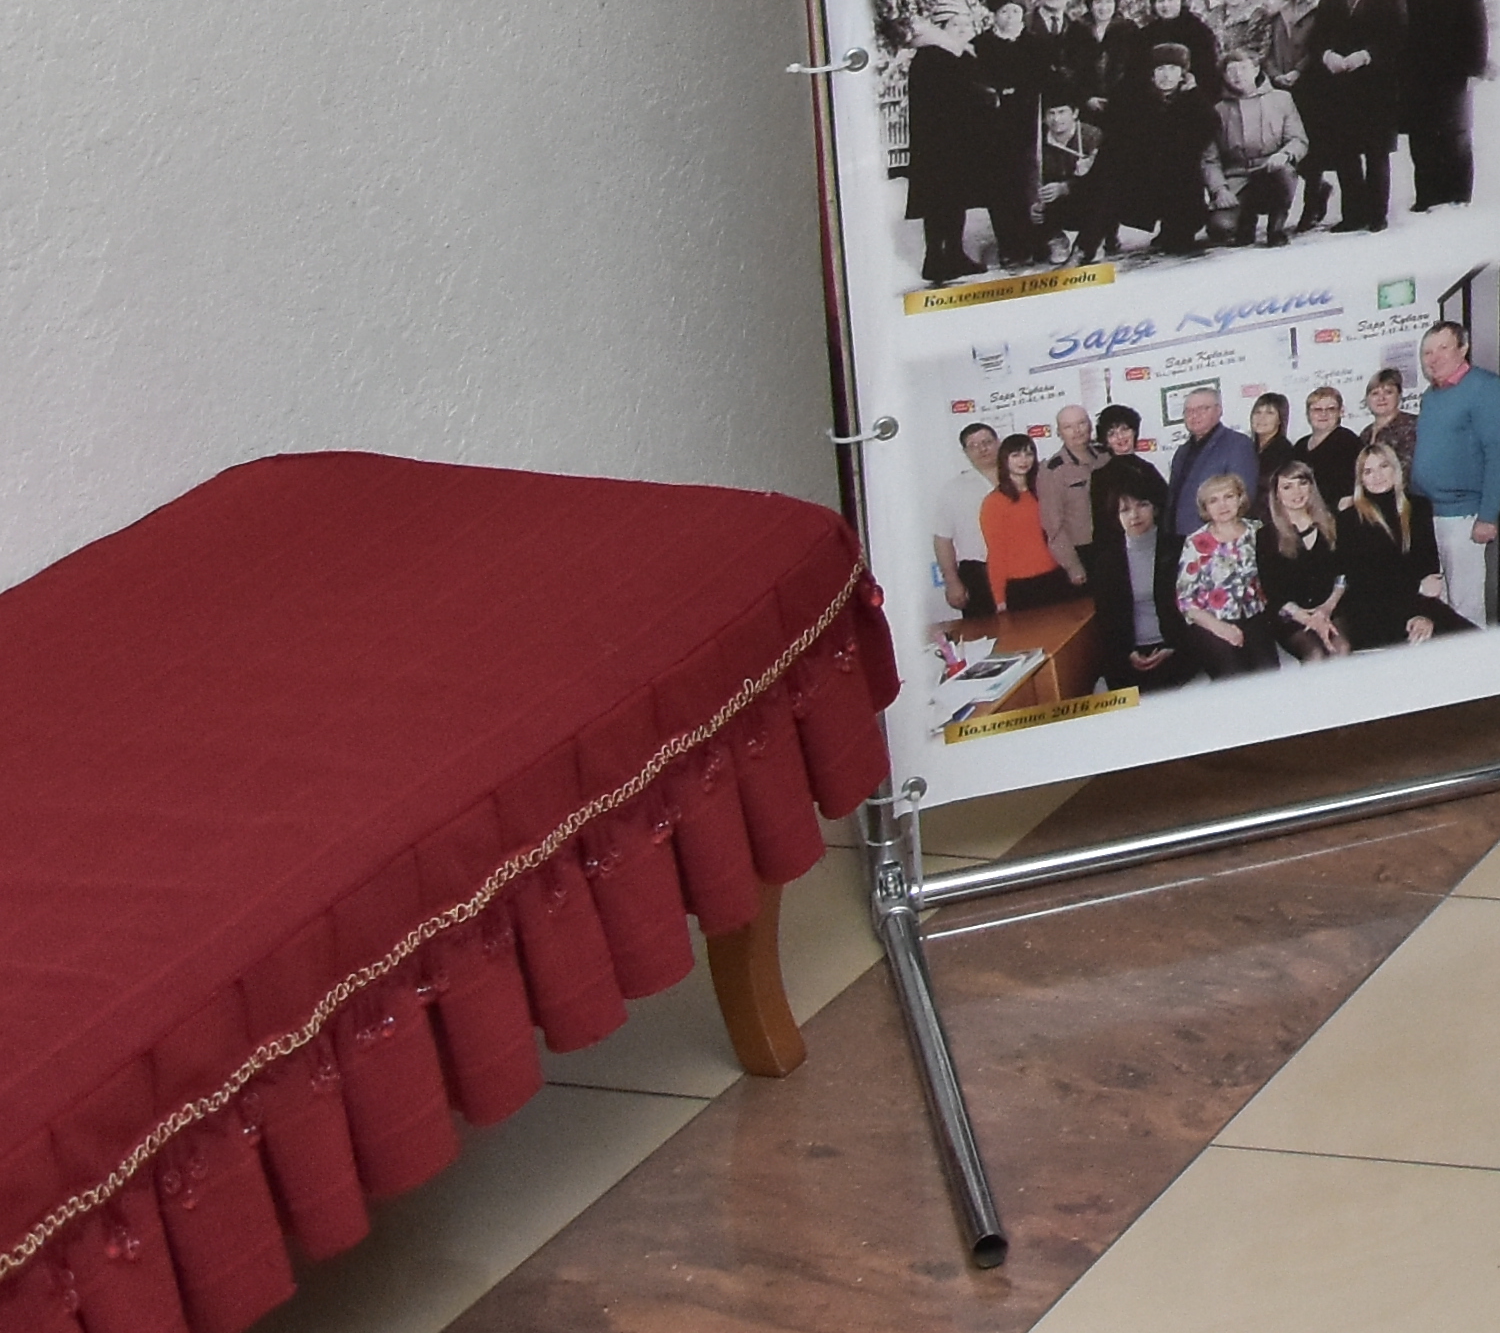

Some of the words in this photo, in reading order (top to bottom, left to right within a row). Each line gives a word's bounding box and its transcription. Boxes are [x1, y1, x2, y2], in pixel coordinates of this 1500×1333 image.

[1020, 273, 1058, 293] 1986
[1061, 271, 1096, 286] года
[1052, 700, 1090, 719] 2016
[1094, 695, 1128, 710] года
